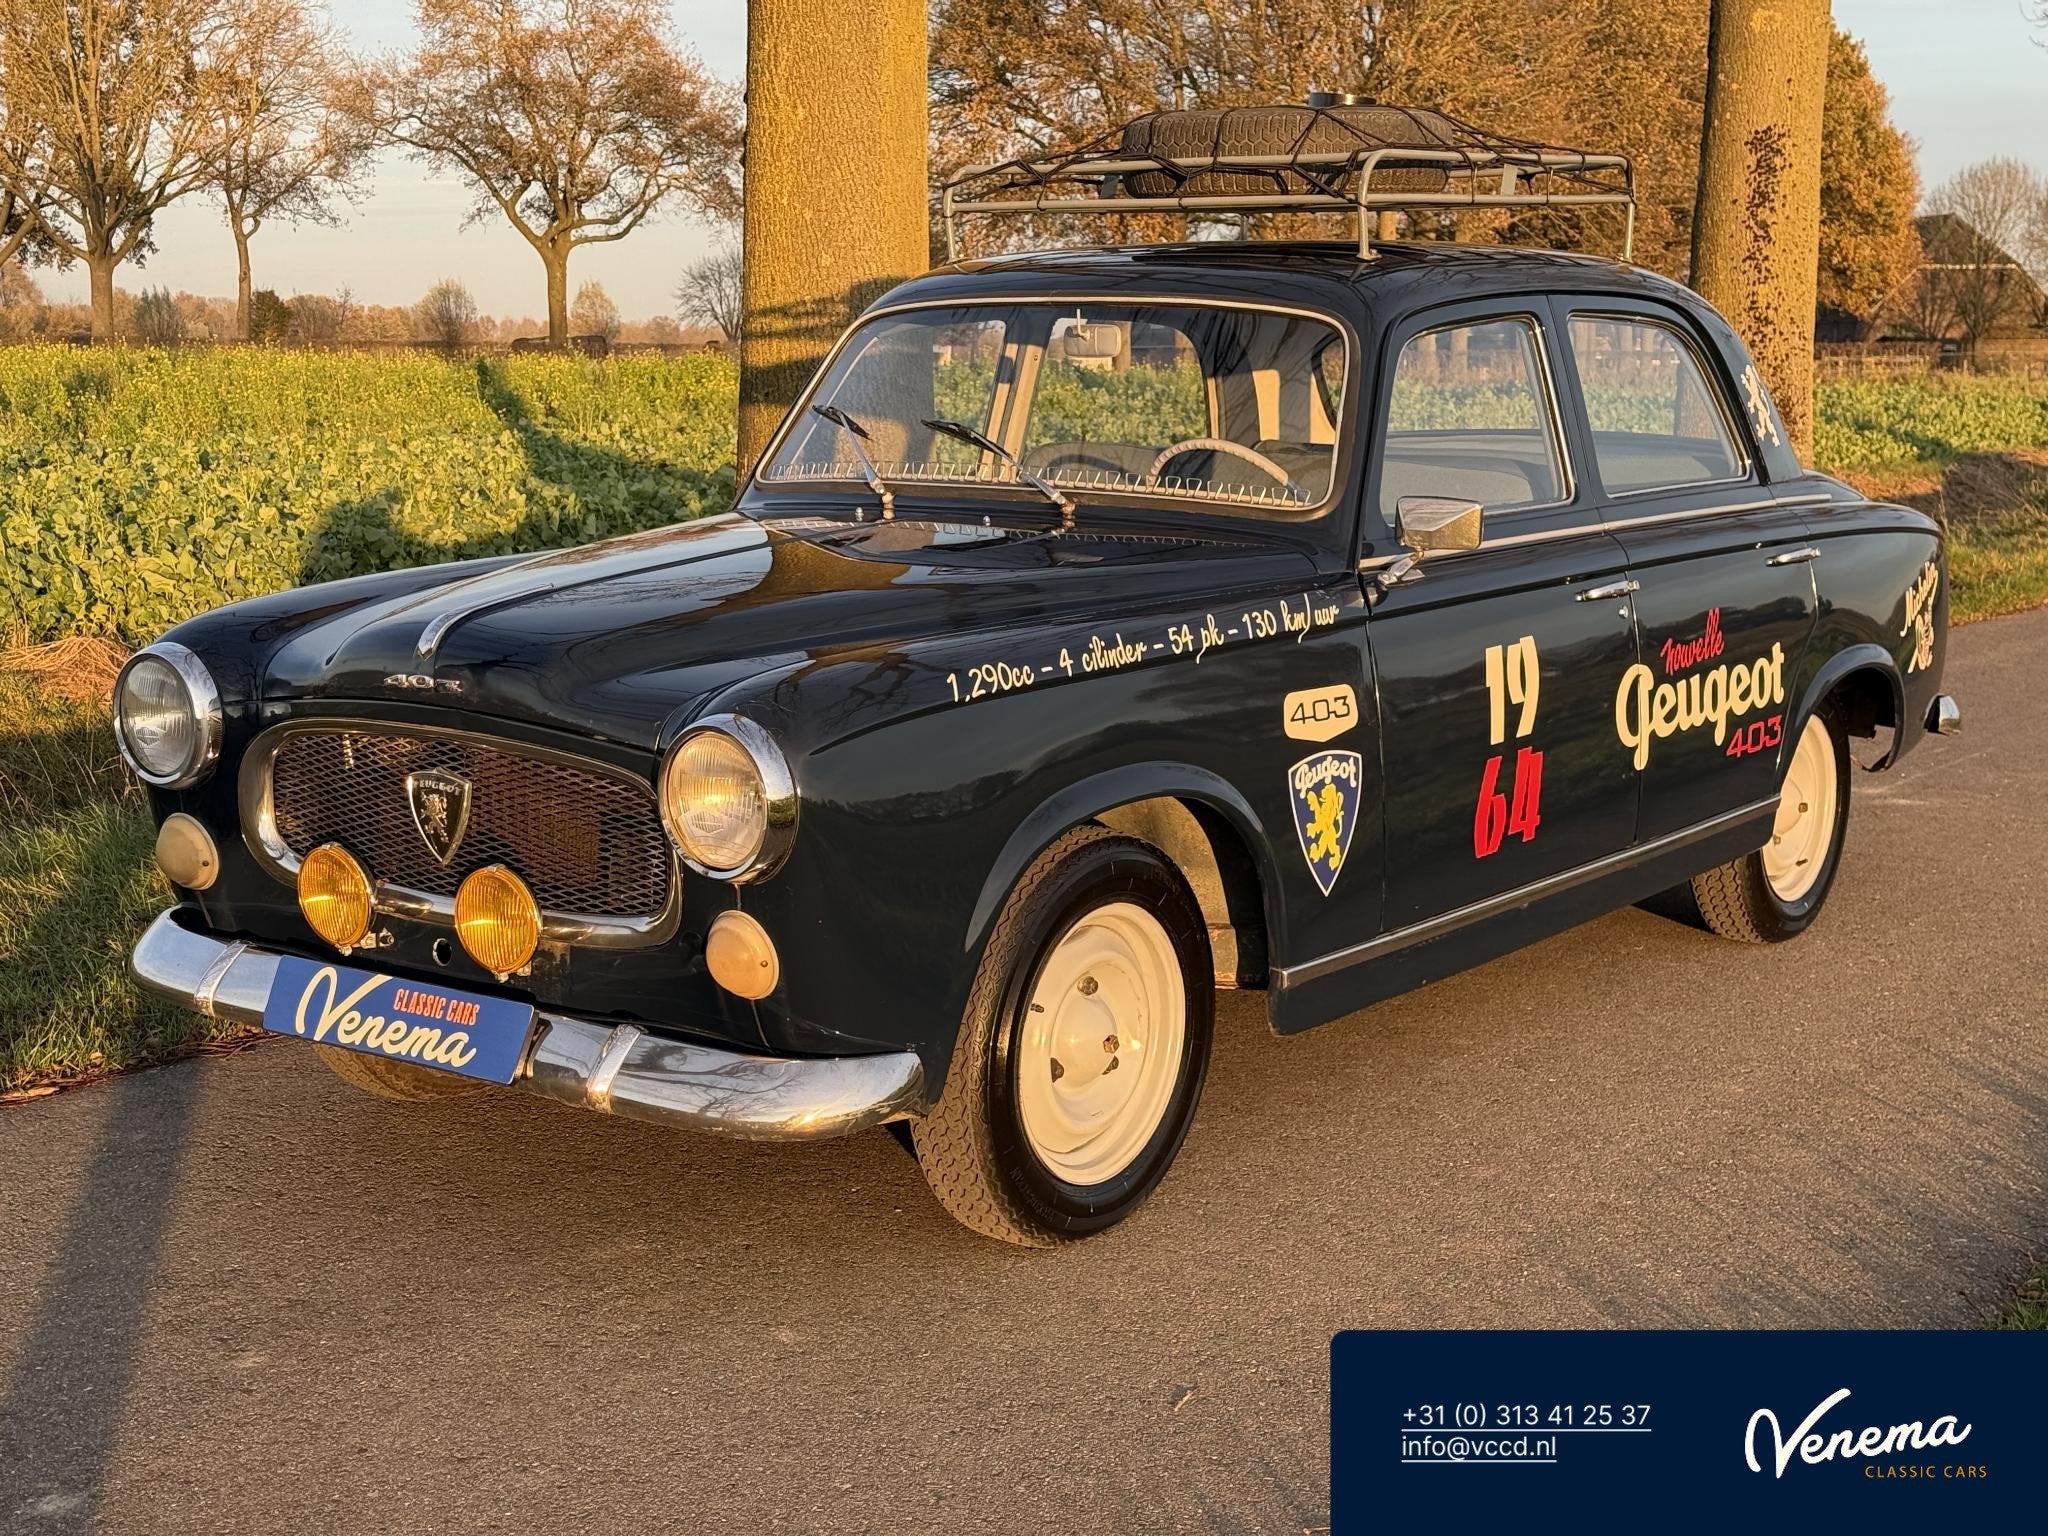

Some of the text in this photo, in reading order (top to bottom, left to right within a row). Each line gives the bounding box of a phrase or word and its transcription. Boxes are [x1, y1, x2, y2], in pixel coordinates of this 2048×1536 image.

[946, 661, 1035, 702] 1,290cc
[1059, 648, 1074, 677] 4
[1082, 632, 1148, 673] cilinder
[1168, 623, 1194, 655] 54
[1196, 613, 1225, 665] pk
[1241, 609, 1277, 640] 130
[1485, 635, 1540, 746] 19
[1290, 695, 1350, 725] 403
[1615, 641, 1785, 771] Peugeot
[1726, 714, 1783, 758] 403
[1294, 755, 1357, 799] Peugeot
[1474, 746, 1543, 858] 64
[295, 966, 477, 1068] Venema
[393, 989, 480, 1026] CLASSIC CARS
